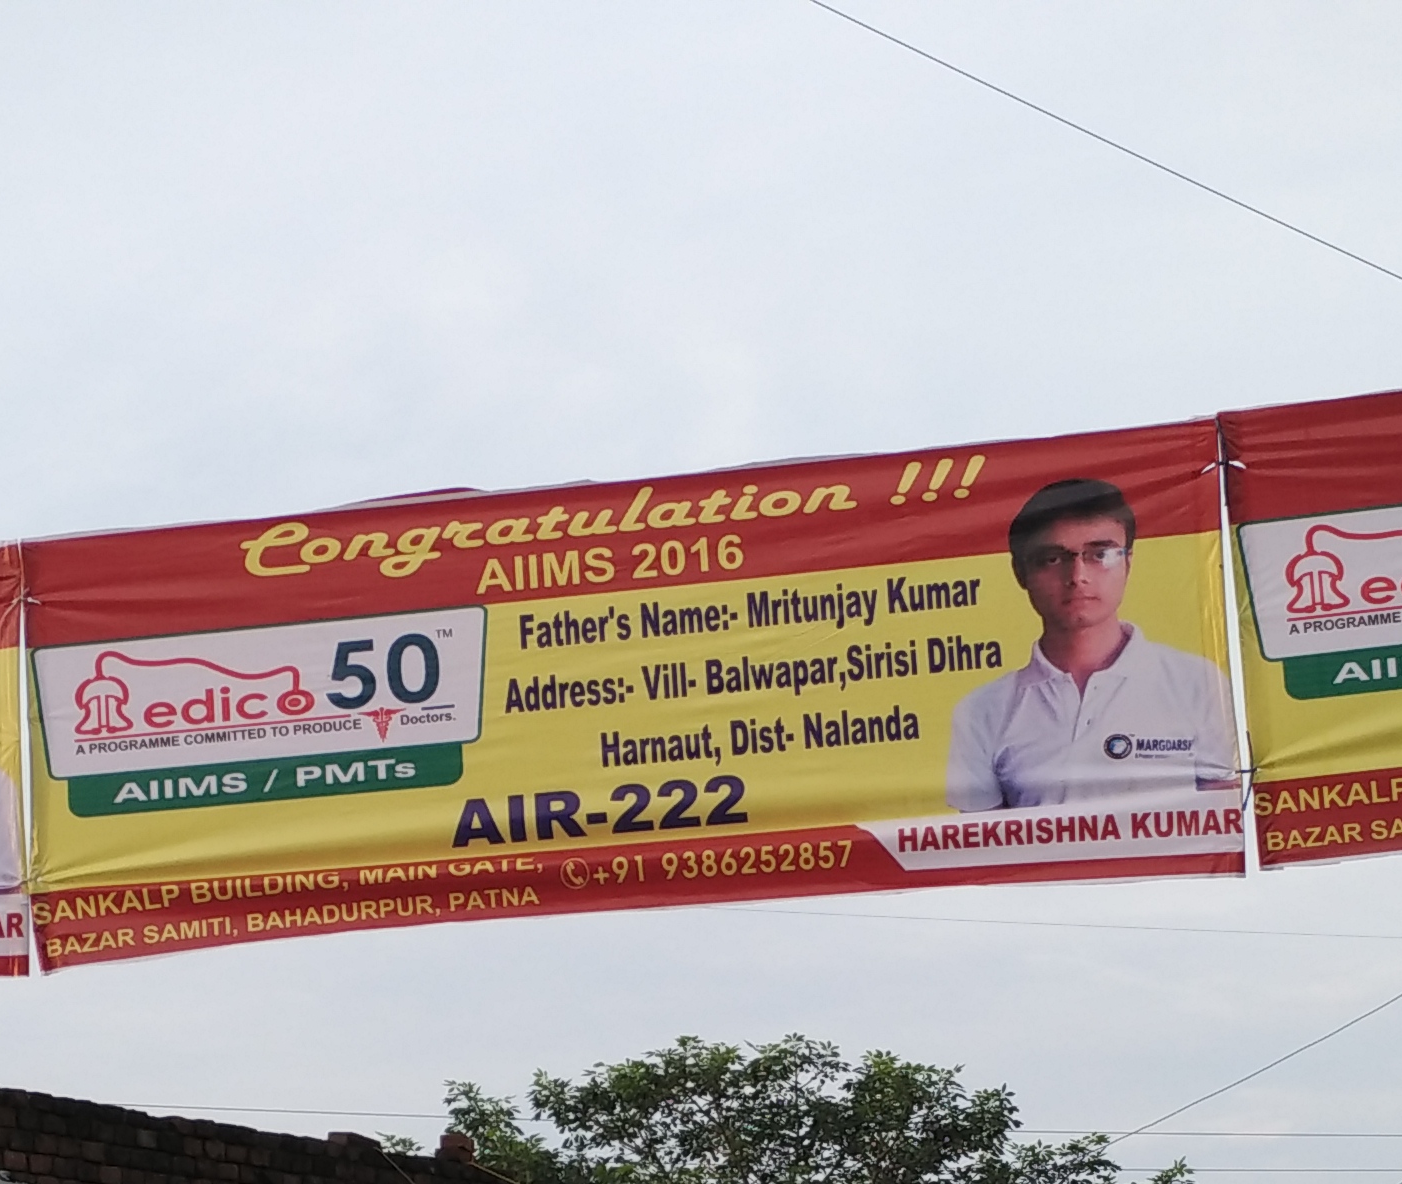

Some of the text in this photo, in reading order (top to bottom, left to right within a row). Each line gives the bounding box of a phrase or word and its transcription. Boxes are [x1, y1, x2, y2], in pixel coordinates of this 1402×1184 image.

[240, 455, 985, 577] Congratulation !!!
[476, 535, 744, 594] AIIMS 2016
[519, 575, 980, 651] Father's Name:- Mritunjay Kumar
[1289, 623, 1300, 635] A
[1302, 611, 1401, 634] PROGRAMME
[505, 636, 1002, 715] Address:- Vill- Balwapar,Sirisi Dihra
[452, 774, 748, 848] AIR-222
[897, 808, 1243, 853] HAREKRISHNA KUMAR
[1265, 821, 1363, 852] BAZAR
